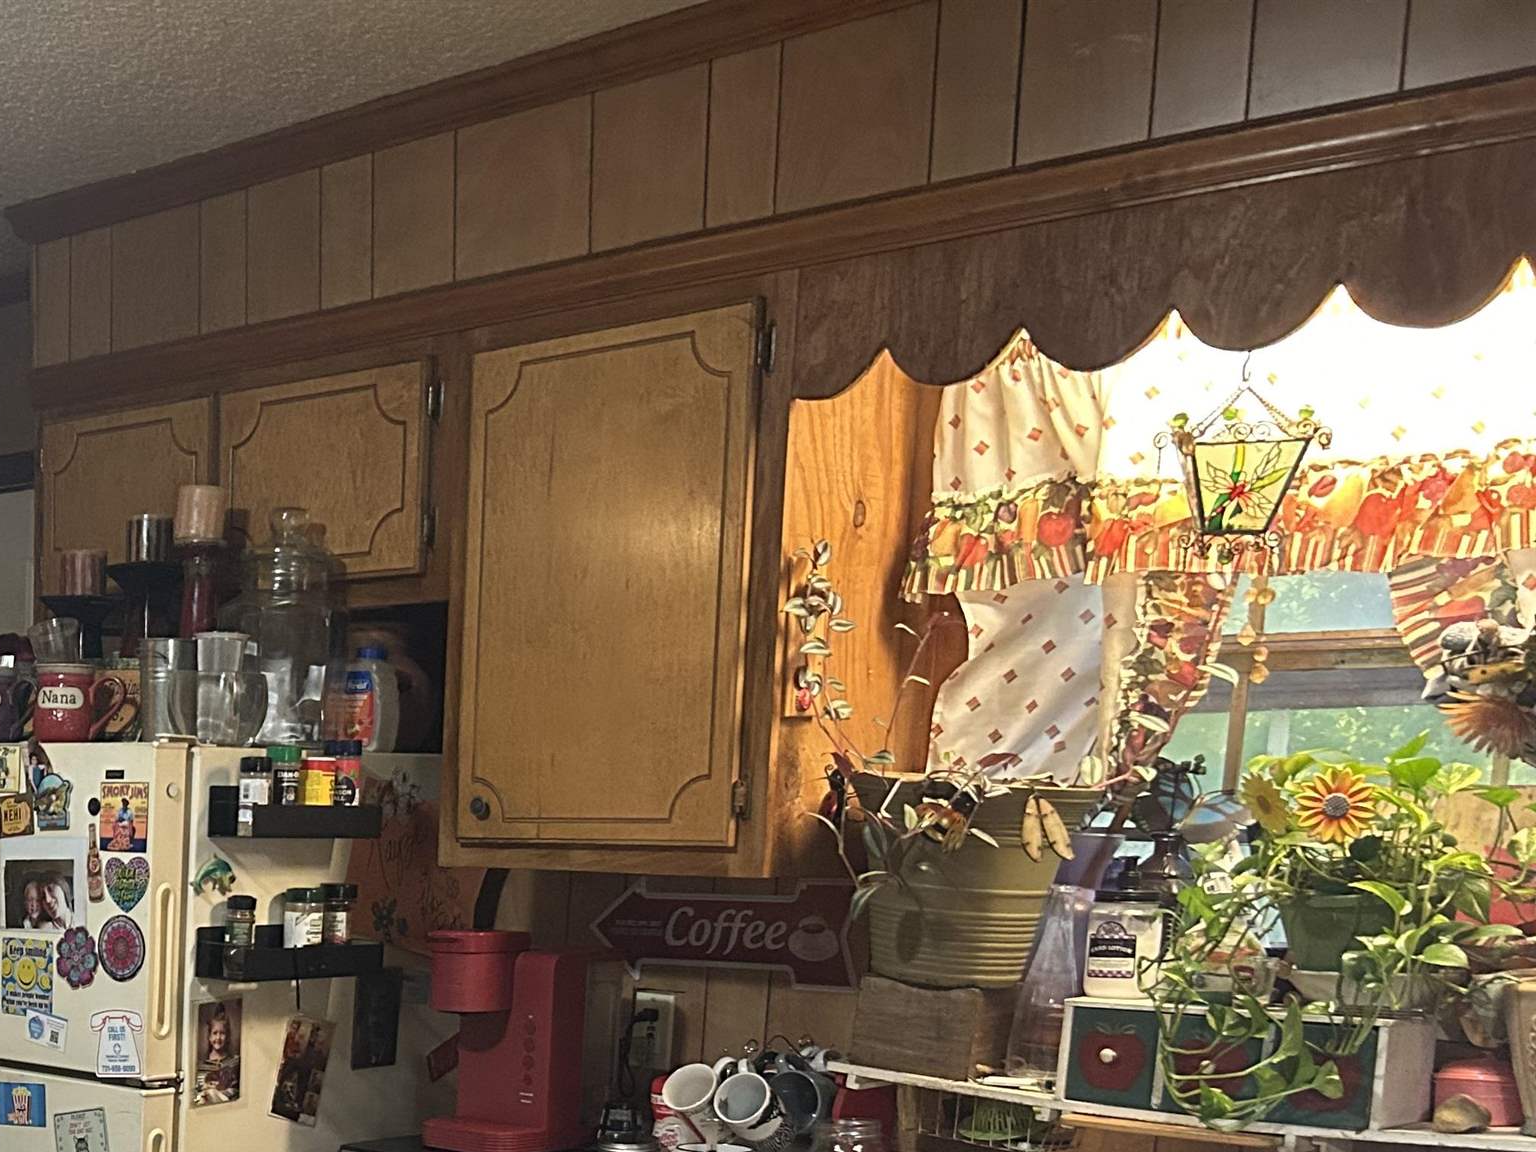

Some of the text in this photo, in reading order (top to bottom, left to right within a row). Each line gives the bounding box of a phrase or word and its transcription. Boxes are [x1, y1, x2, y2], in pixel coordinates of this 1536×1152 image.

[41, 690, 77, 705] Nana
[3, 809, 22, 822] NEHI
[664, 906, 788, 956] Coffee
